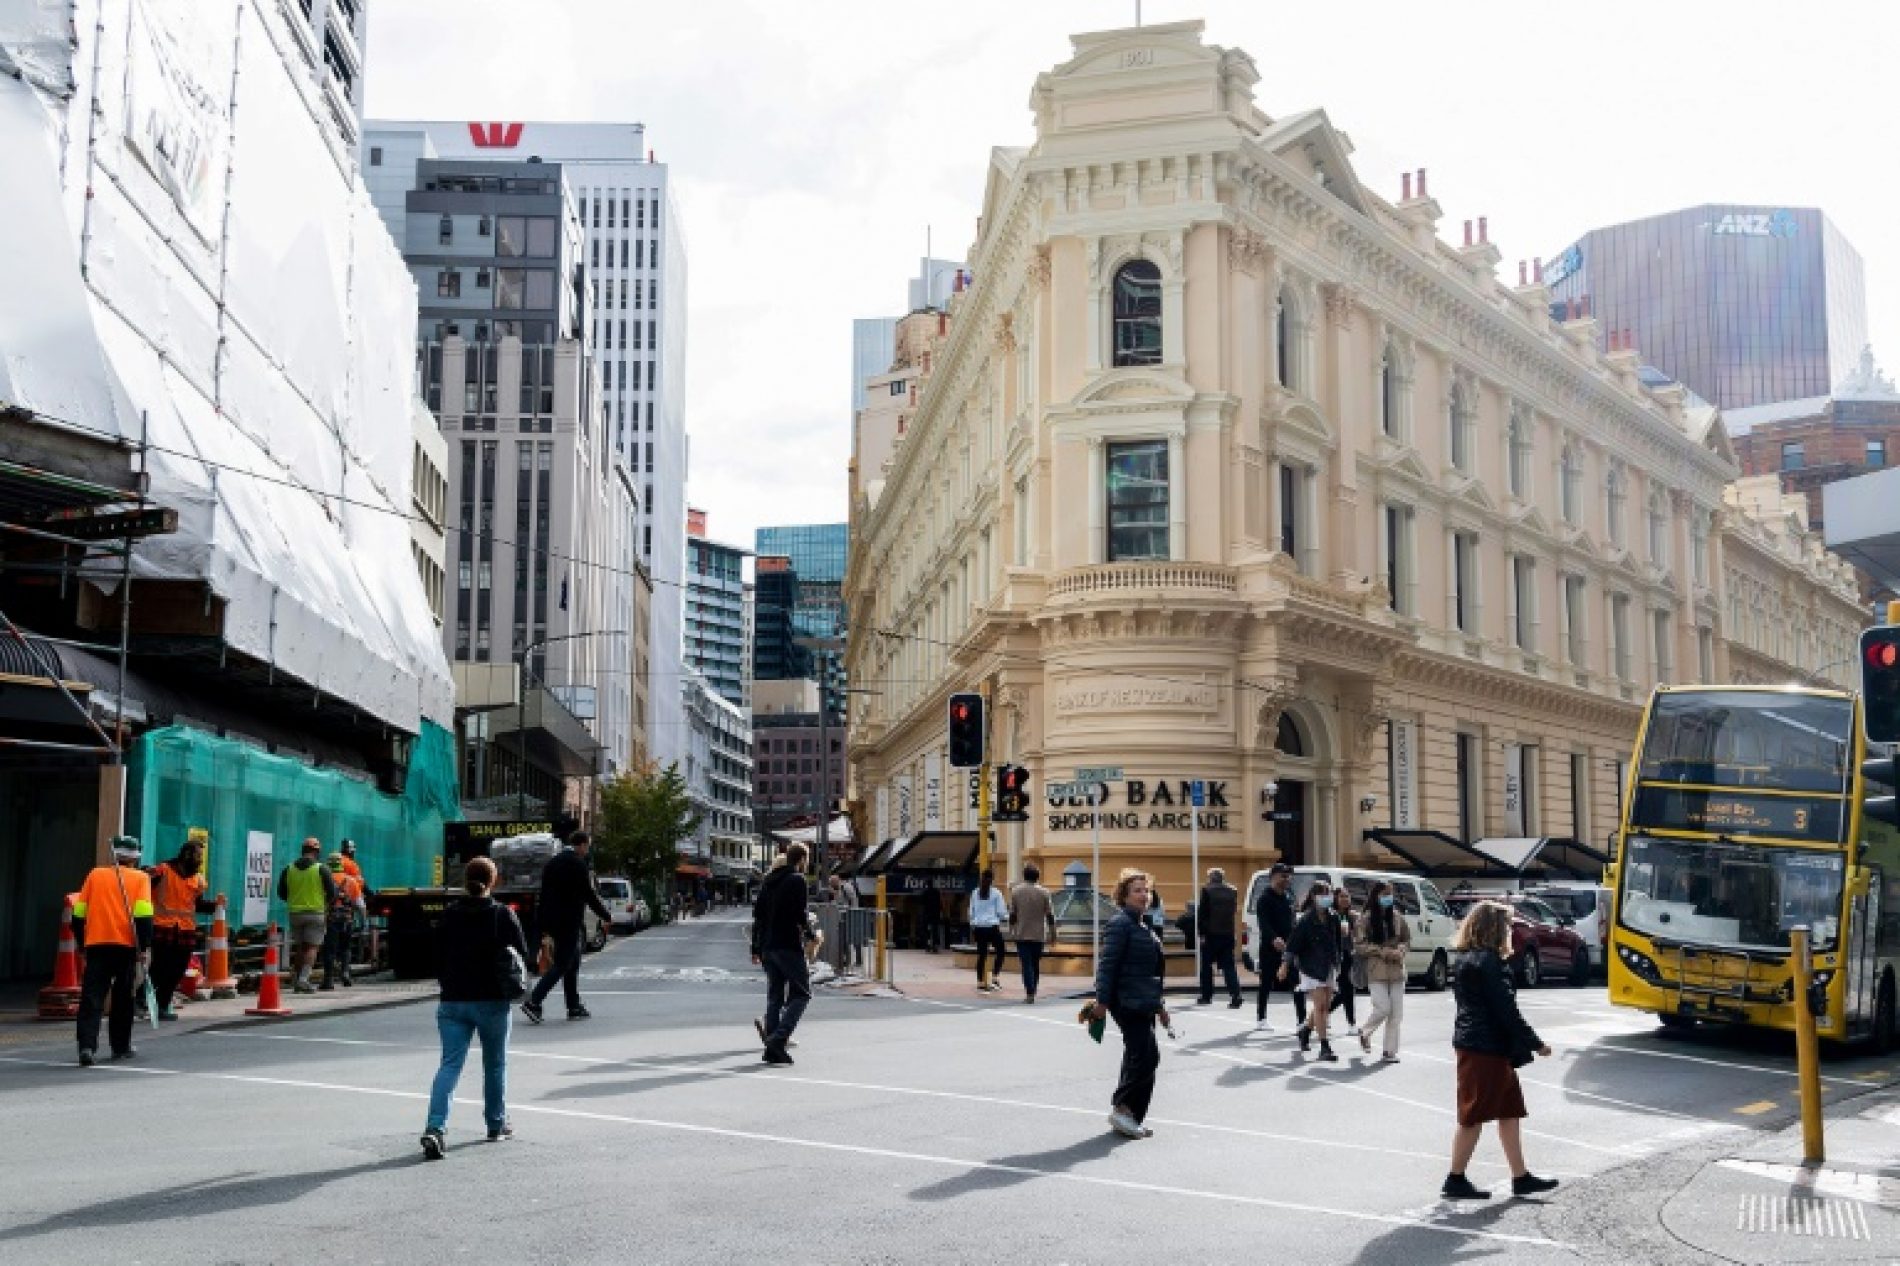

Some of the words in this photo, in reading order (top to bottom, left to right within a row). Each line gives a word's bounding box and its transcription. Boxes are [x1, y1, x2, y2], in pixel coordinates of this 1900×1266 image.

[1713, 213, 1770, 235] ANZ
[1127, 780, 1230, 807] BANK
[1793, 809, 1807, 829] 3
